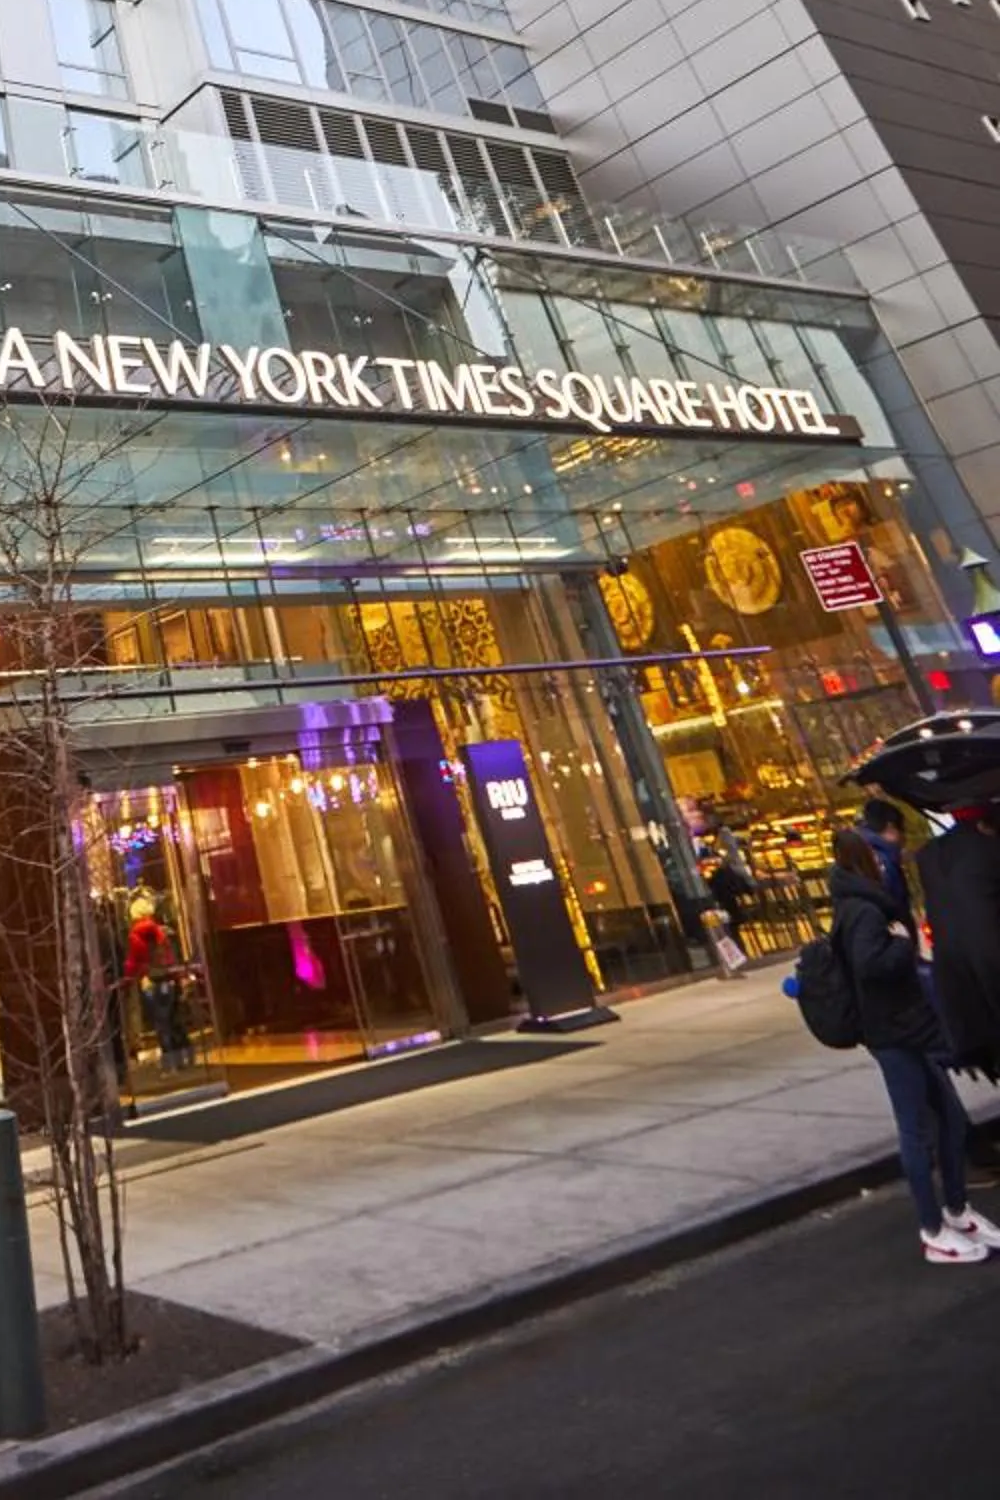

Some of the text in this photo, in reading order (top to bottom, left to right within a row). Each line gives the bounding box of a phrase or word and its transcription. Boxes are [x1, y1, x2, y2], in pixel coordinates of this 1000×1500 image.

[55, 330, 213, 399] NEW
[219, 345, 382, 408] YORK
[371, 357, 536, 417] TIMES
[535, 367, 714, 434] SQUARE
[706, 385, 841, 435] HOTEL
[486, 777, 528, 809] RIU
